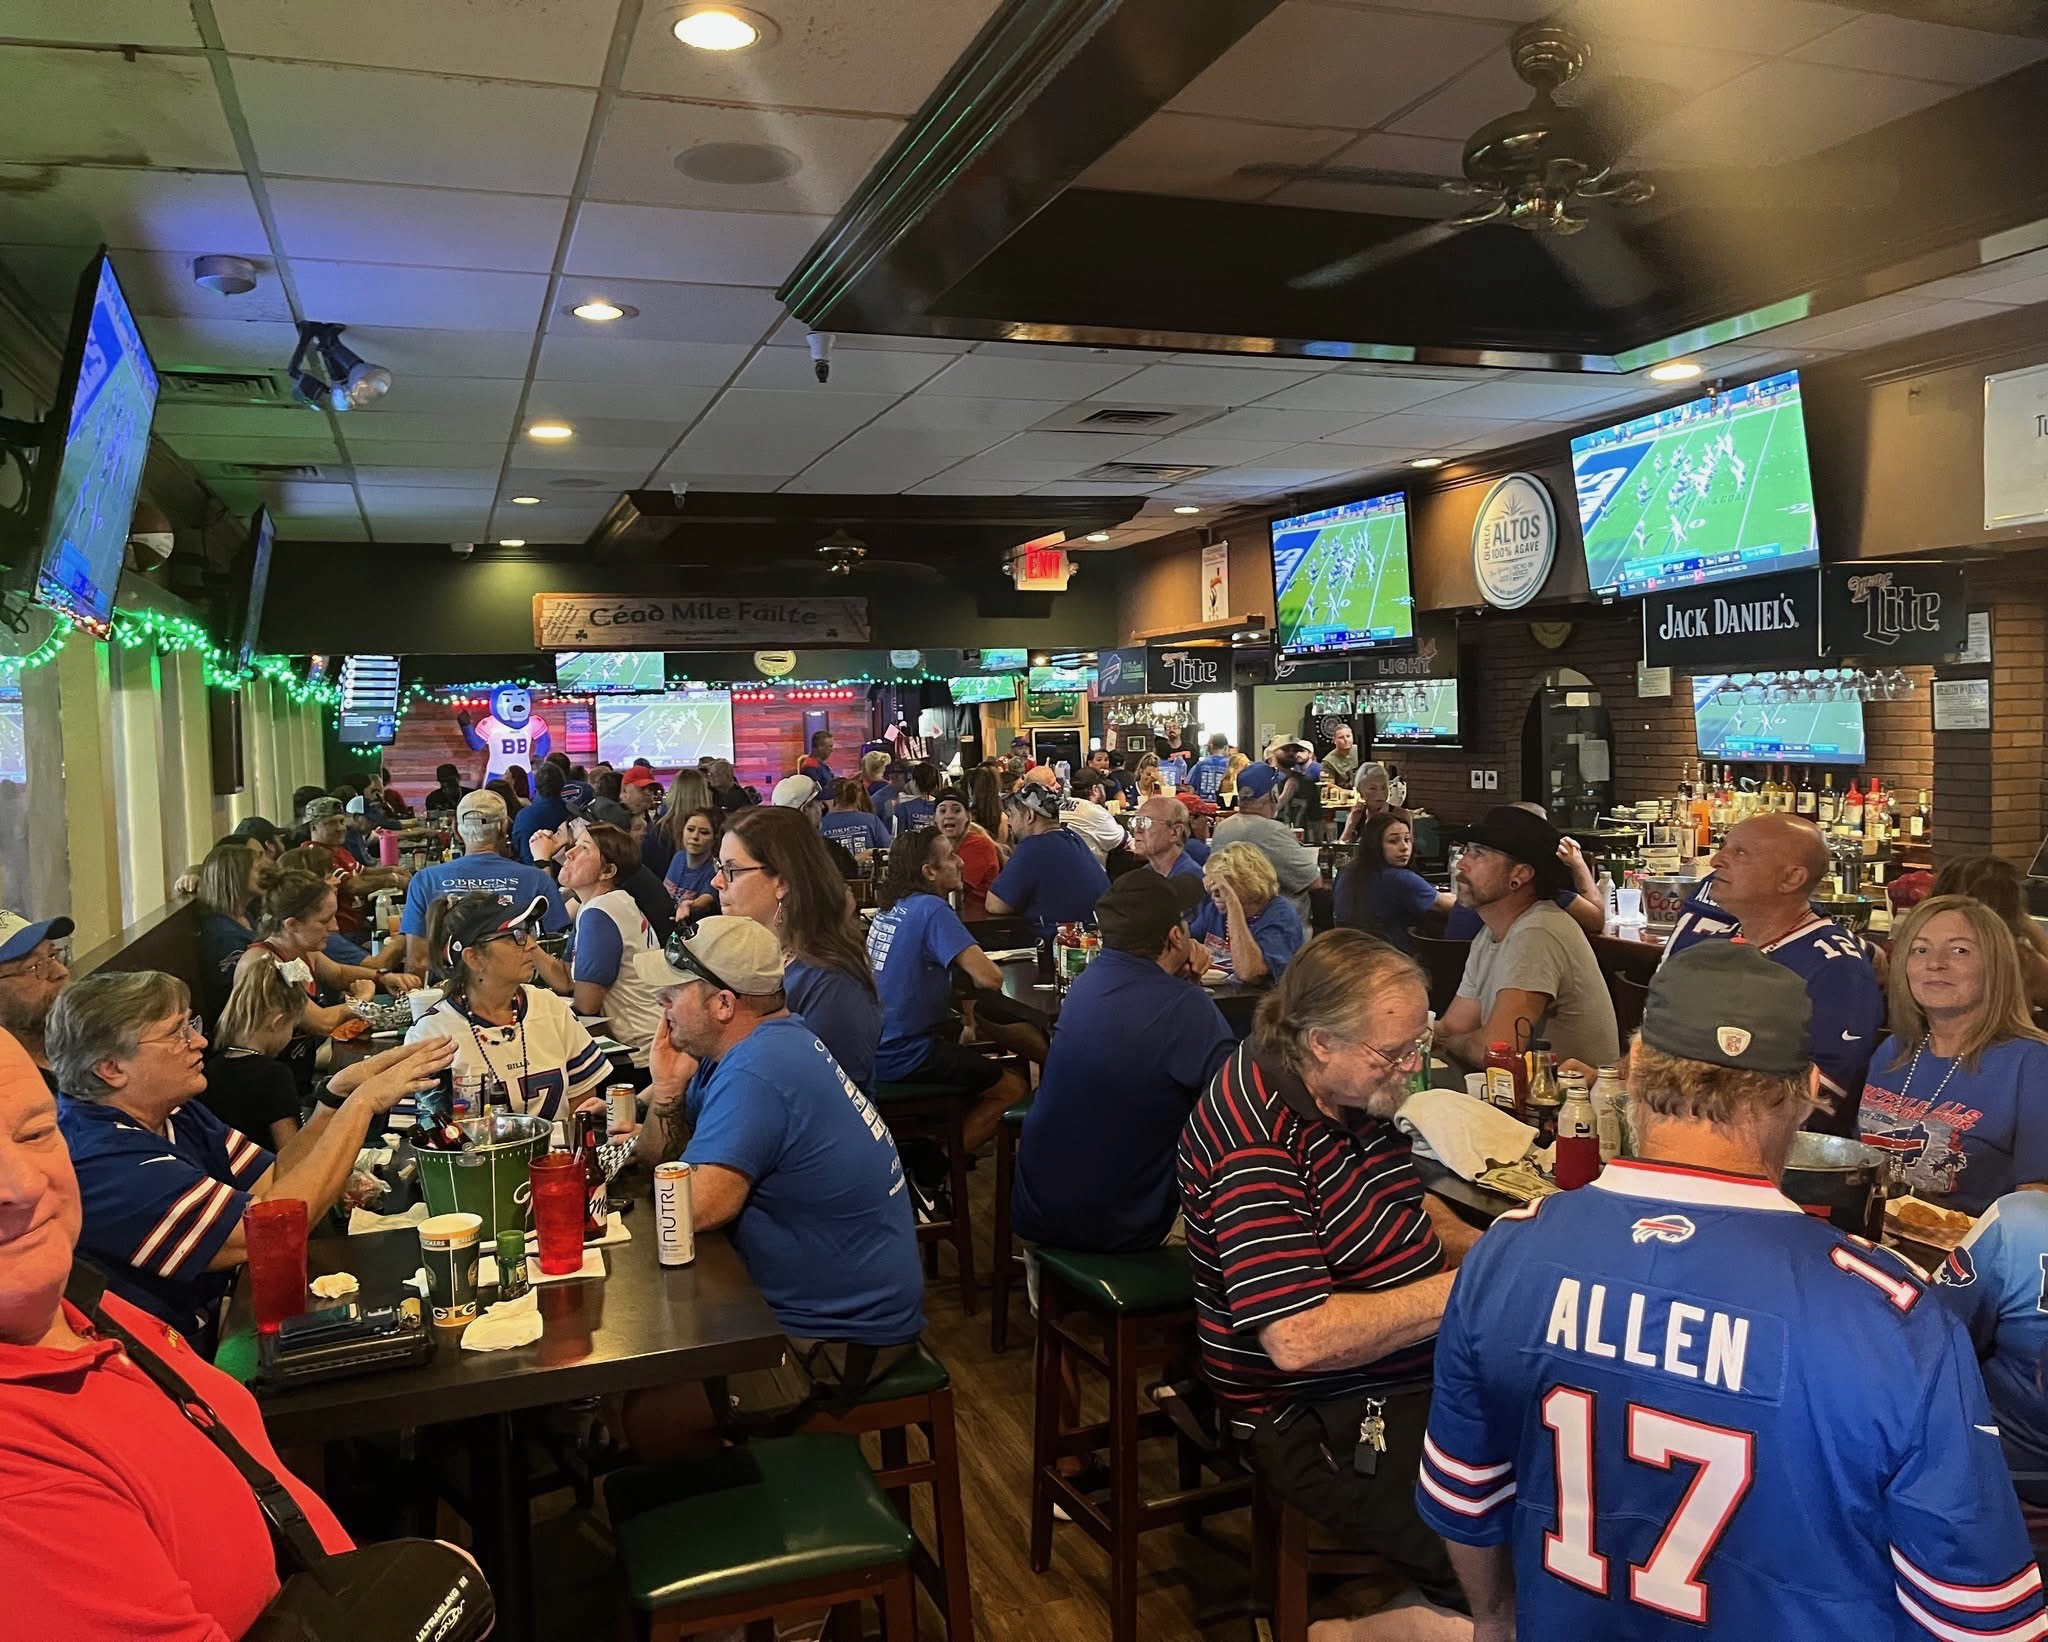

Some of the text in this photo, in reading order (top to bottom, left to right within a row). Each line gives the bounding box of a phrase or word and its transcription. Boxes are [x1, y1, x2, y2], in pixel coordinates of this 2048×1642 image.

[1493, 514, 1540, 546] ALTOS
[1027, 551, 1062, 579] EXIT
[1491, 540, 1540, 559] 100% AGAVE
[1659, 604, 1709, 641] JACK
[1864, 586, 1942, 646] Lite
[1170, 658, 1218, 690] Lite
[1378, 657, 1432, 675] LIGHT
[501, 738, 528, 755] BB
[1813, 934, 1863, 960] 12
[1546, 1277, 1750, 1392] ALLEN
[1540, 1383, 1757, 1629] 17
[415, 1587, 460, 1642] ULTRASLING
